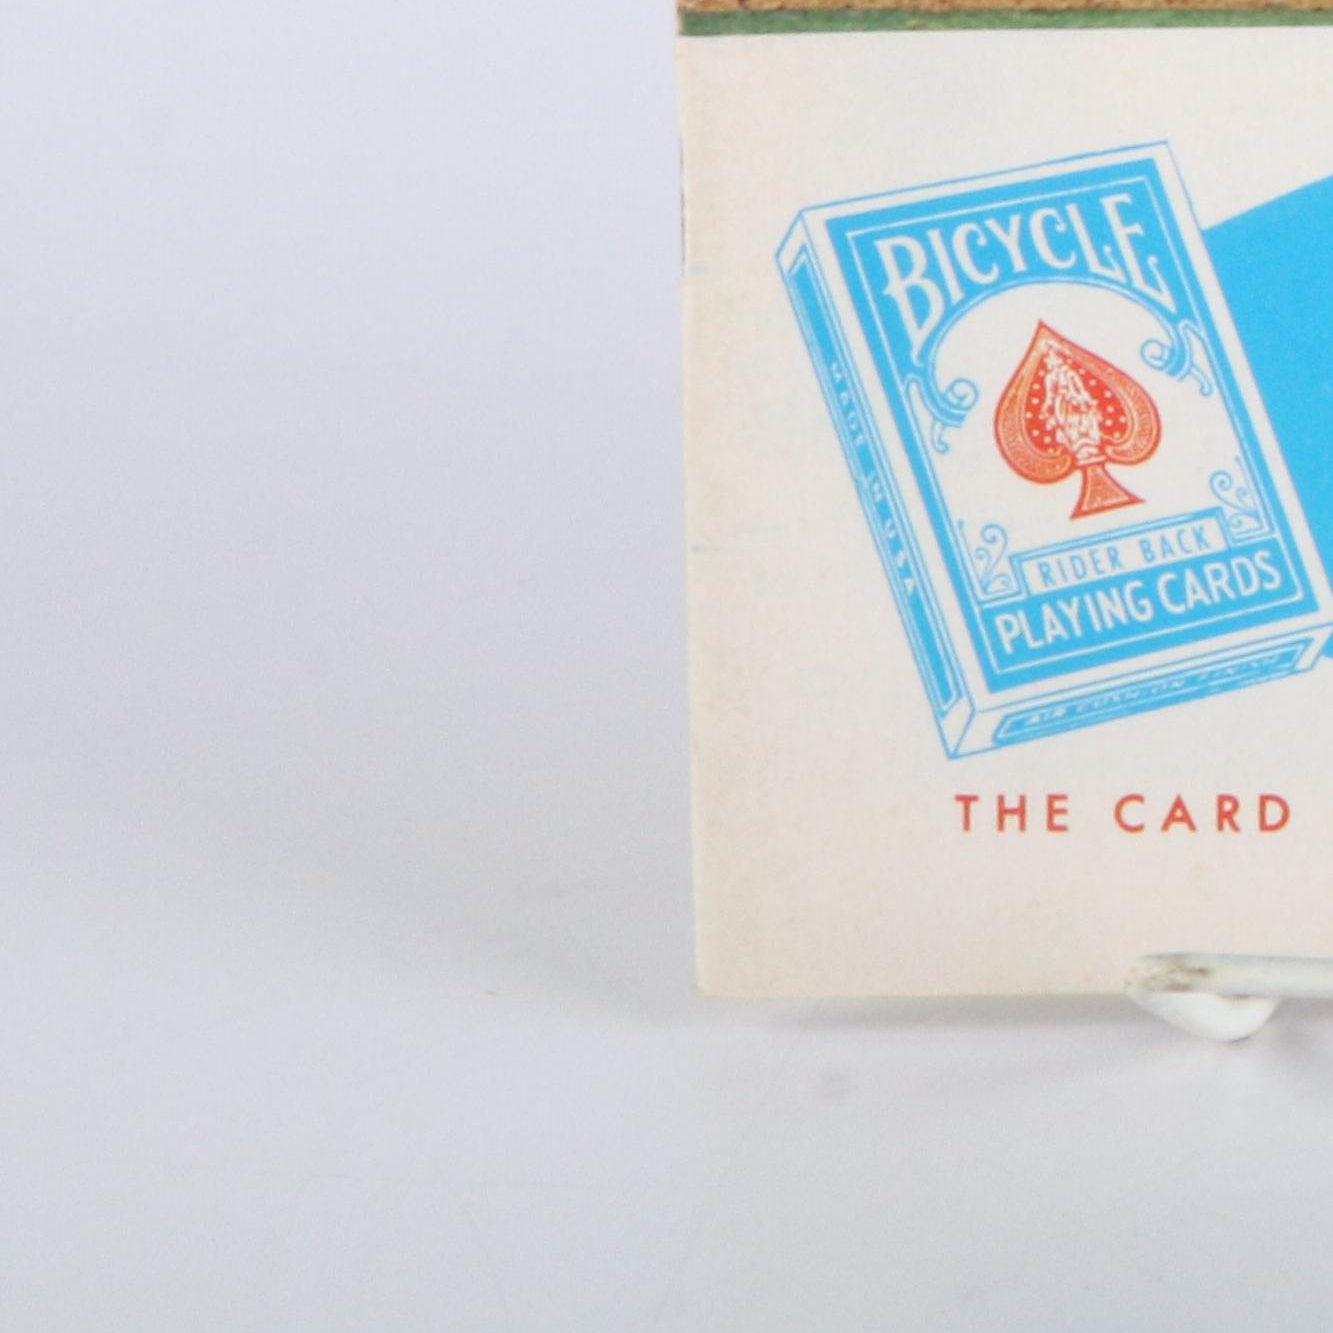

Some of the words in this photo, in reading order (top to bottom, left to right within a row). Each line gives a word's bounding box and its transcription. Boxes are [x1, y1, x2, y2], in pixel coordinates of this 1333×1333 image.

[873, 192, 1178, 367] BICYCLE
[1036, 547, 1125, 588] RIDER
[1140, 523, 1214, 564] BACK
[994, 579, 1155, 654] PLAYING
[1161, 549, 1283, 616] CARDS
[955, 793, 1070, 834] THE
[1113, 793, 1292, 834] CARD
